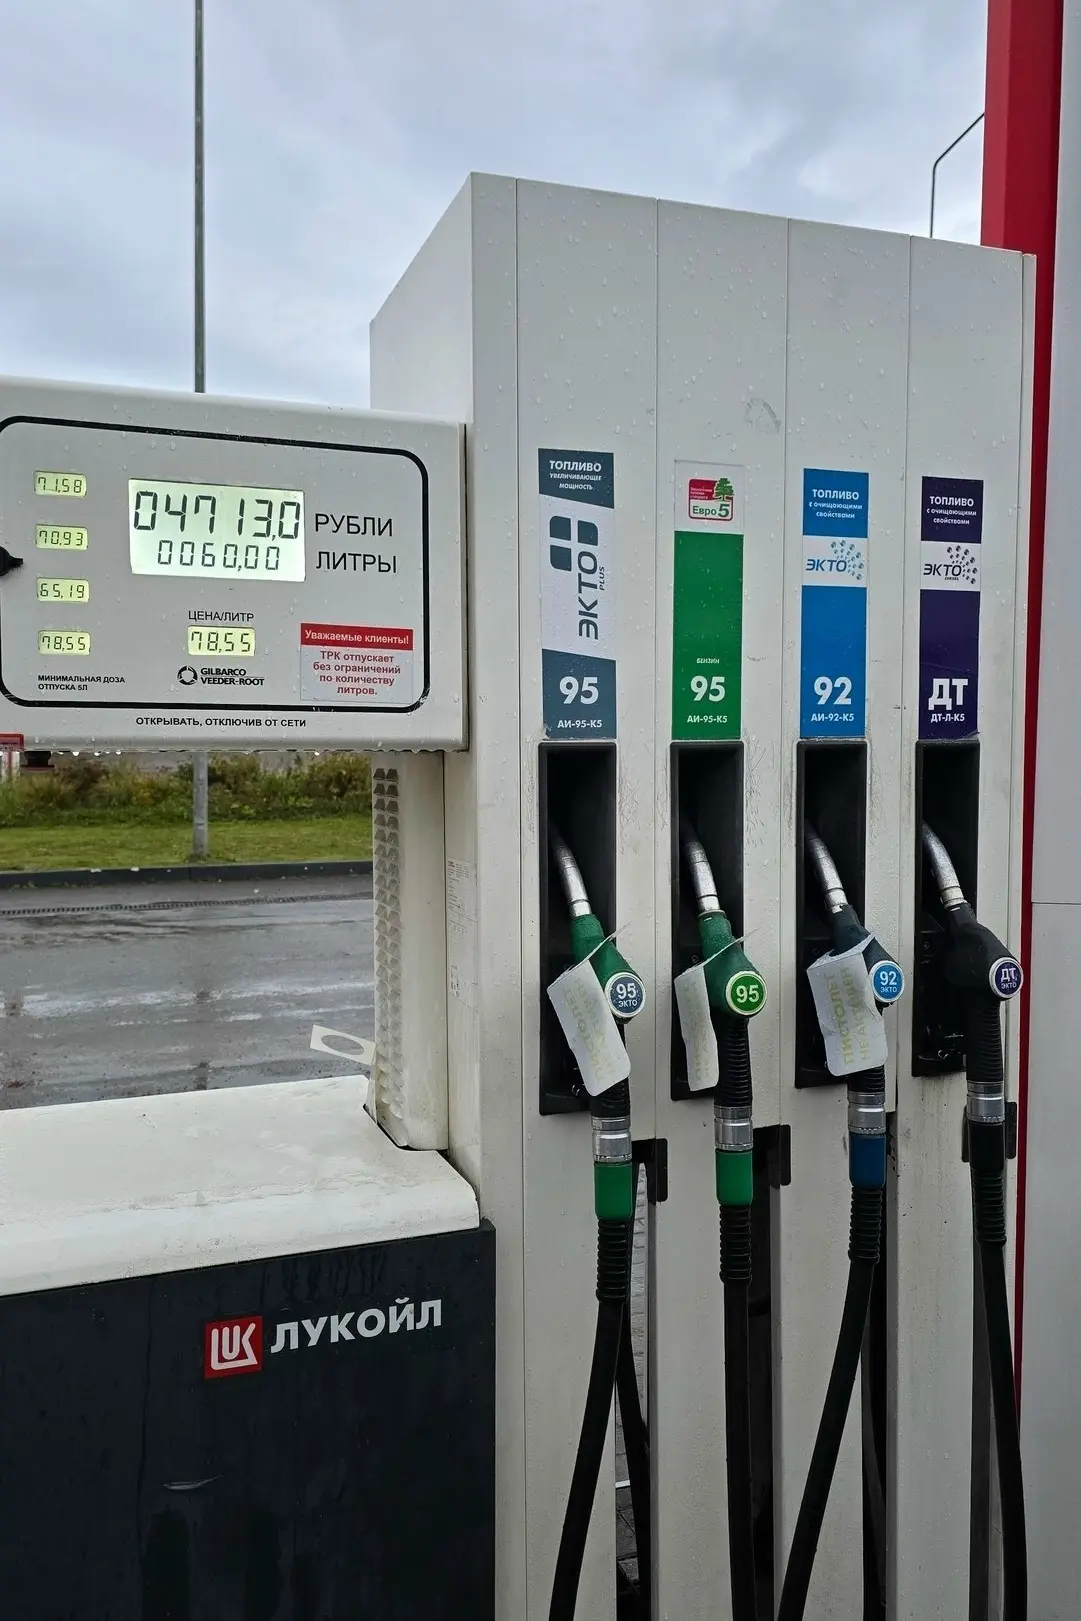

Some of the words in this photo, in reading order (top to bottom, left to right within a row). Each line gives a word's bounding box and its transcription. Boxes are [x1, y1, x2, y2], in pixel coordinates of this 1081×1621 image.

[549, 460, 602, 472] ТОПЛИВО
[549, 473, 602, 482] УВЕЛИЧИВАЮЩЕЕ
[37, 475, 82, 494] 71,58
[559, 482, 594, 491] МОЩНОСТЬ
[812, 488, 860, 501] ТОПЛИВО
[929, 495, 975, 507] ТОПЛИВО
[692, 505, 717, 517] Евро
[717, 503, 730, 518] 5
[814, 501, 863, 511] очищающими
[931, 507, 977, 517] очищающими
[133, 490, 301, 542] 04713,0
[815, 510, 856, 520] свойствами
[933, 516, 970, 526] свойствами
[315, 513, 394, 537] РУБЛИ
[38, 529, 84, 547] 70,93
[157, 539, 281, 572] 0060,00
[315, 551, 397, 574] ЛИТРЫ
[805, 558, 848, 573] ЭКТО
[923, 563, 962, 577] ЭКТО
[598, 565, 606, 591] PLUS
[39, 583, 85, 600] 65,19
[578, 551, 599, 640] ЭКТО
[188, 610, 254, 623] ЦЕНА/ЛИТР
[41, 635, 86, 652] 78,55
[190, 631, 252, 654] 78,55
[304, 629, 362, 643] Уважаемые
[364, 634, 410, 645] клиенты!
[320, 651, 342, 661] ТРК
[343, 653, 395, 664] отпускает
[200, 668, 247, 677] GILBARCO
[312, 661, 332, 671] без
[334, 663, 401, 675] ограничений
[38, 674, 101, 684] МИНИМАЛЬНАЯ
[102, 676, 126, 685] ДОЗА
[200, 677, 265, 687] VEEDER-ROOT
[319, 675, 333, 683] по
[335, 674, 395, 686] количеству
[38, 683, 76, 692] ОТПУСКА
[77, 684, 88, 692] 5Л
[336, 686, 378, 696] литров.
[559, 676, 600, 705] 95
[690, 675, 727, 703] 95
[814, 676, 853, 706] 92
[928, 677, 969, 711] ДТ
[135, 716, 203, 728] ОТКРЫВАТЬ,
[205, 718, 262, 728] ОТКЛЮЧИВ
[264, 718, 279, 727] ОТ
[280, 718, 307, 728] СЕТИ
[557, 718, 603, 729] АИ-95-К5
[687, 714, 728, 725] АИ-95-К5
[811, 712, 855, 723] АИ-92-К5
[930, 712, 966, 723] ДТ-Л-К5
[879, 970, 898, 986] 92
[1000, 967, 1016, 983] ДТ
[616, 982, 637, 1000] 95
[880, 986, 898, 994] ЭКТО
[1000, 982, 1017, 990] ЭКТО
[735, 984, 760, 1004] 95
[618, 999, 638, 1008] ЭКТО
[270, 1296, 443, 1355] ЛУКОЙЛ
